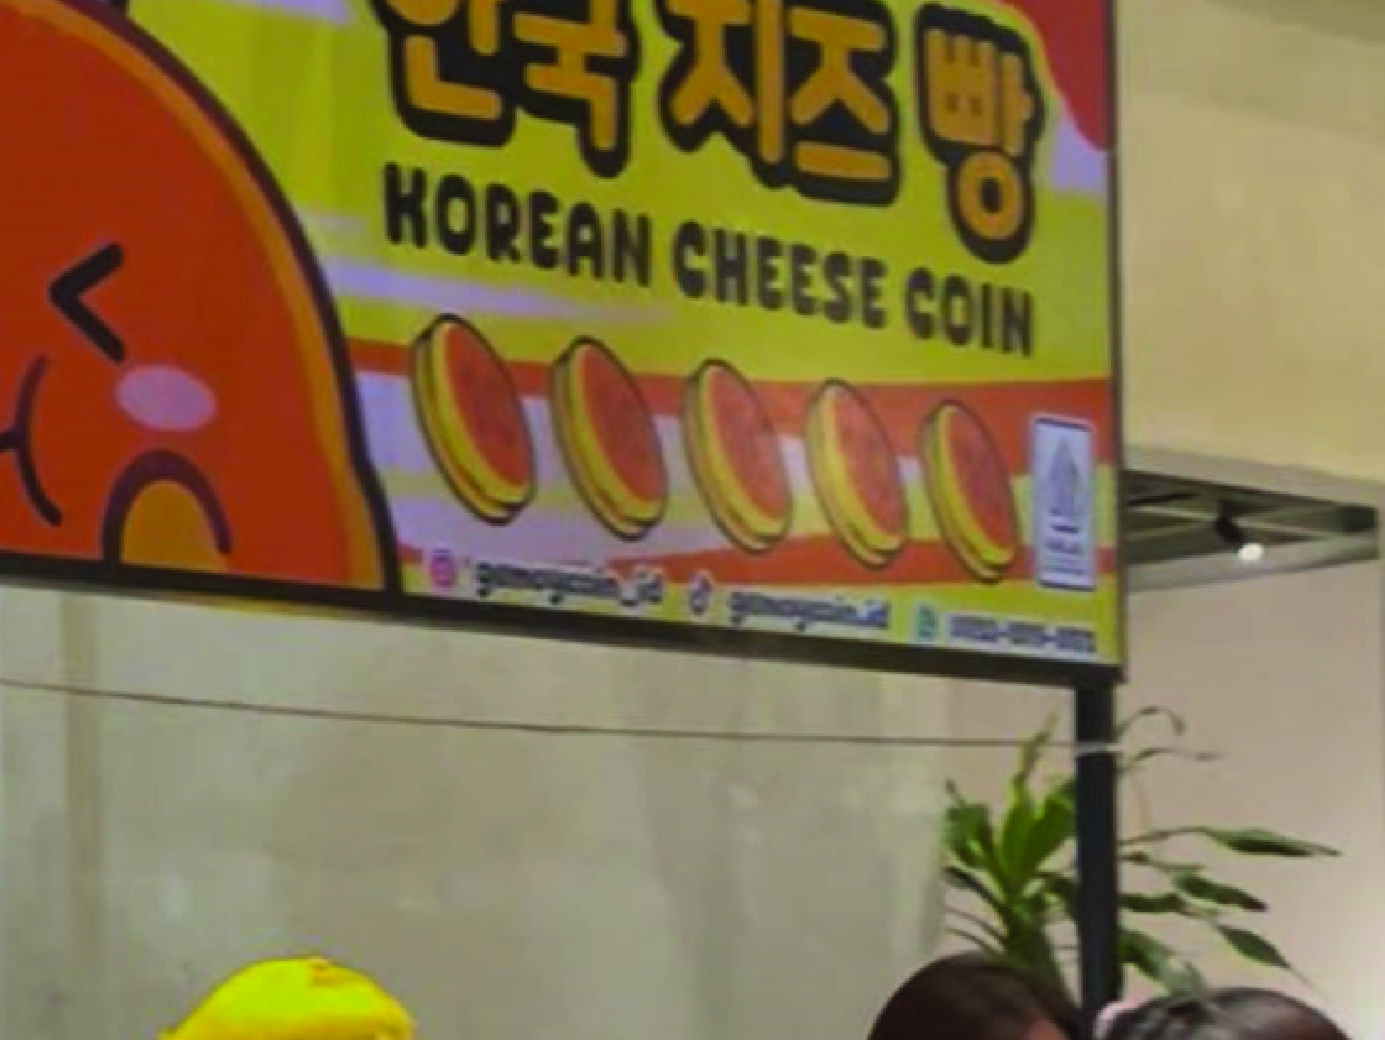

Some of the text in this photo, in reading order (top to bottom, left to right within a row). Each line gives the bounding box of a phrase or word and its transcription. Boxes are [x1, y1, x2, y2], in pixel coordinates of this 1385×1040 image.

[917, 5, 1046, 263] 빵
[383, 162, 1034, 357] KOREAN CHEESE COIN
